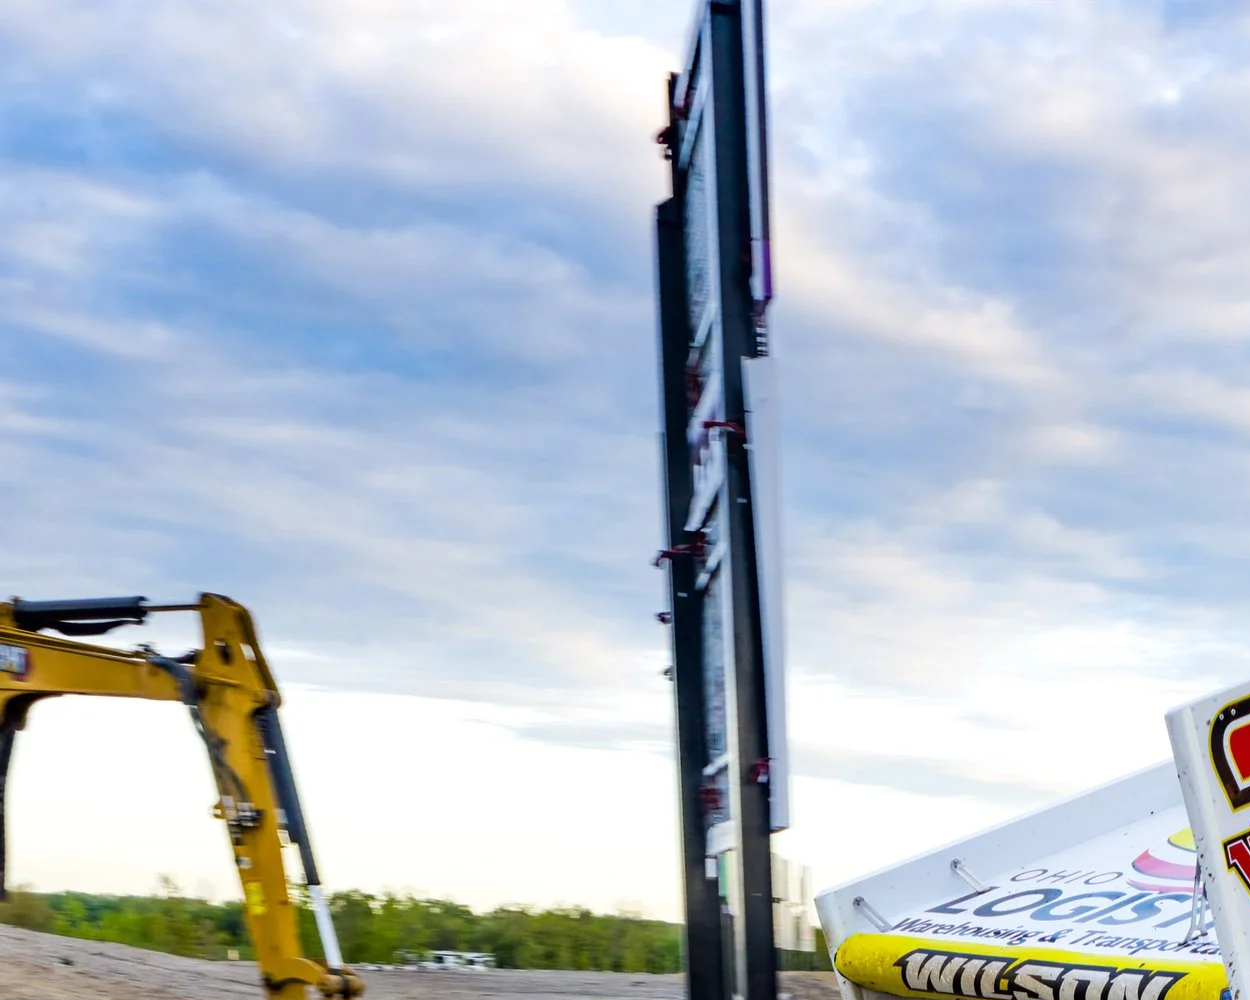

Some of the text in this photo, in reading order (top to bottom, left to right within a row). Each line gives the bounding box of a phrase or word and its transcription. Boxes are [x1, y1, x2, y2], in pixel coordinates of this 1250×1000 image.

[1011, 868, 1123, 885] OHIO
[890, 918, 1037, 945] Warehousing
[1037, 929, 1073, 943] &
